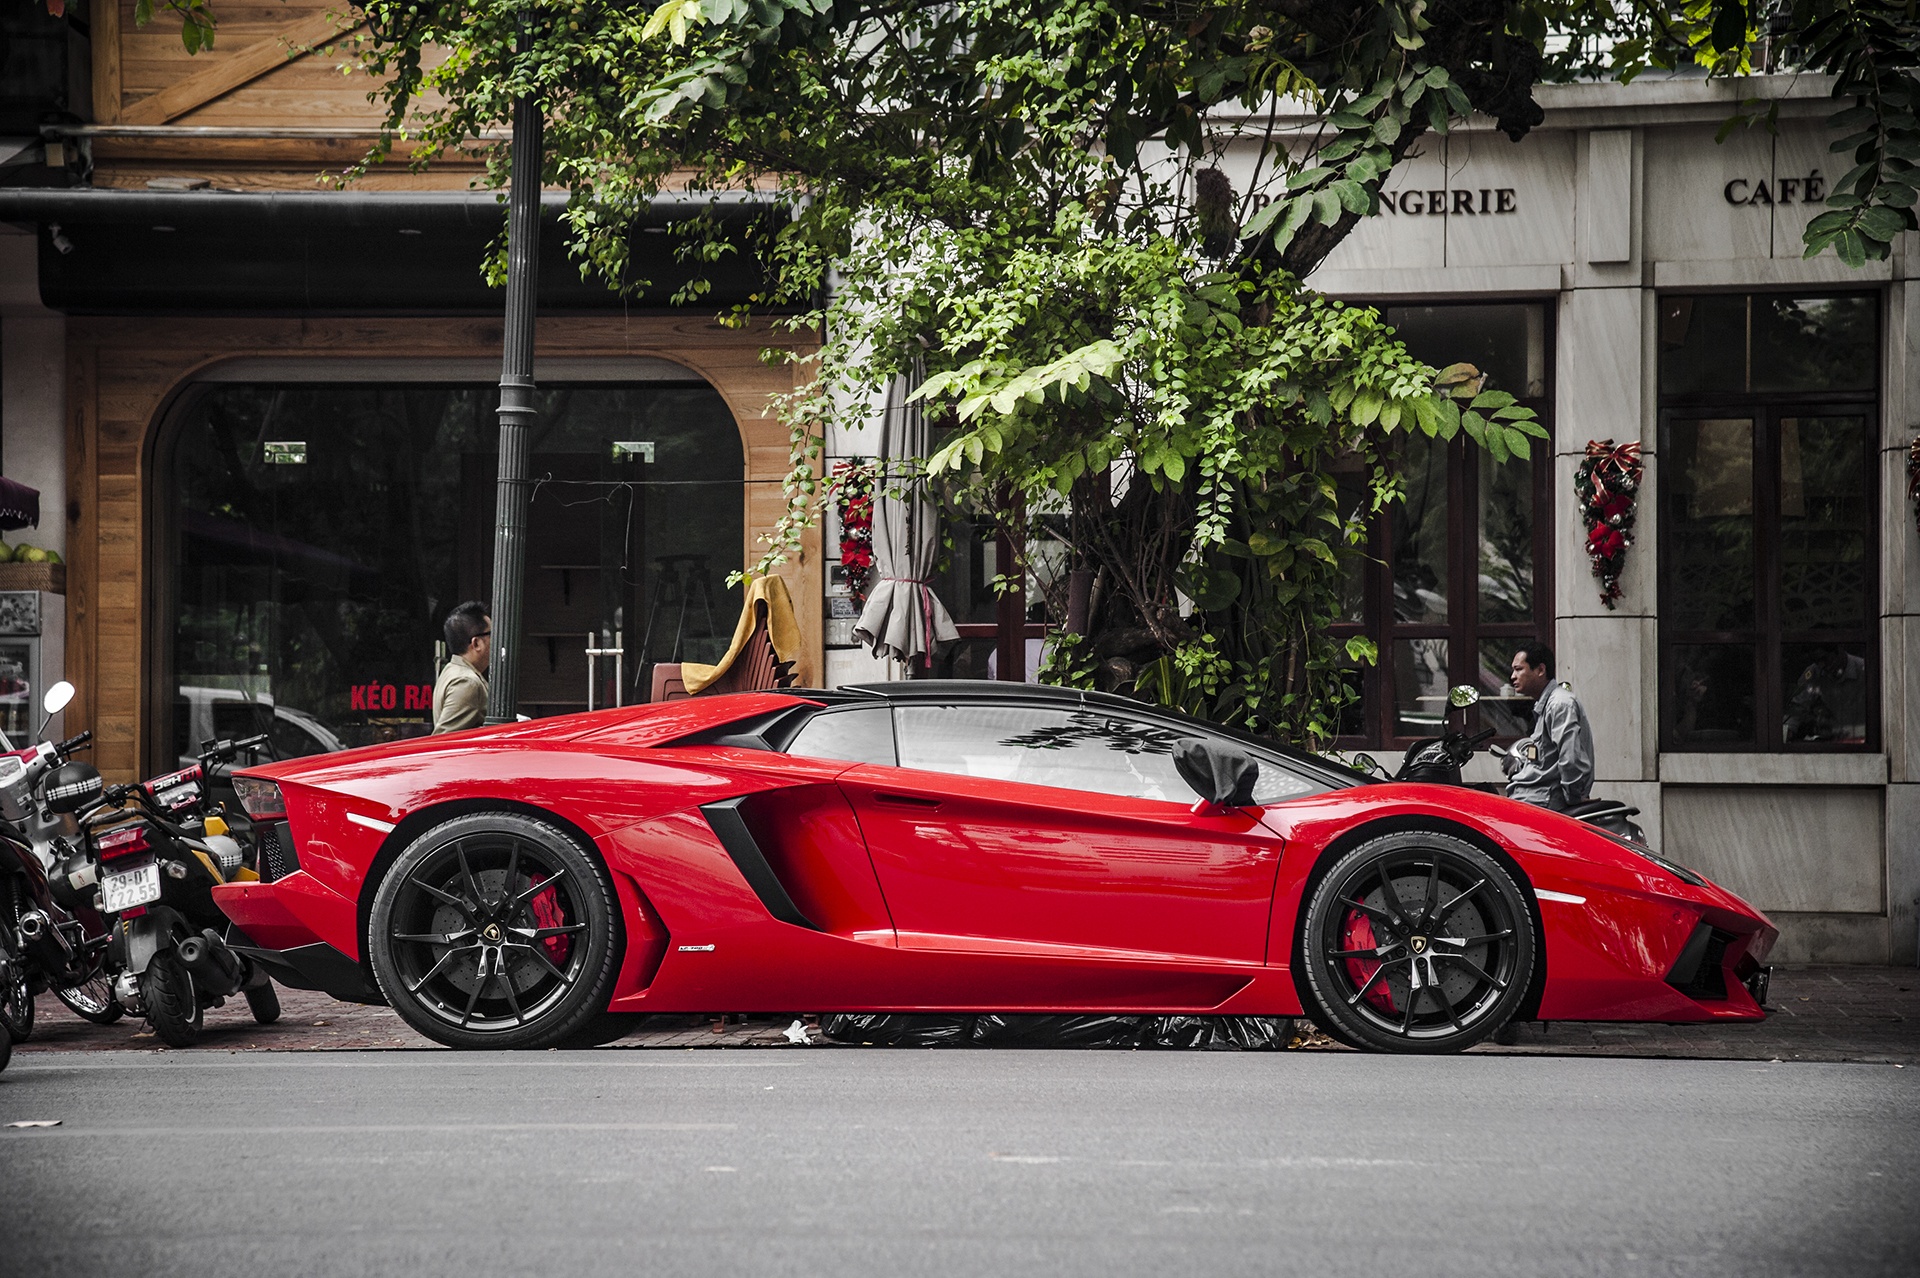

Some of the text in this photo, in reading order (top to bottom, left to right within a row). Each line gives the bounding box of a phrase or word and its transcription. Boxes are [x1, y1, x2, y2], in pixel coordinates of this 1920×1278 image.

[1723, 169, 1825, 205] CAFÉ
[351, 680, 433, 711] KÉO RA
